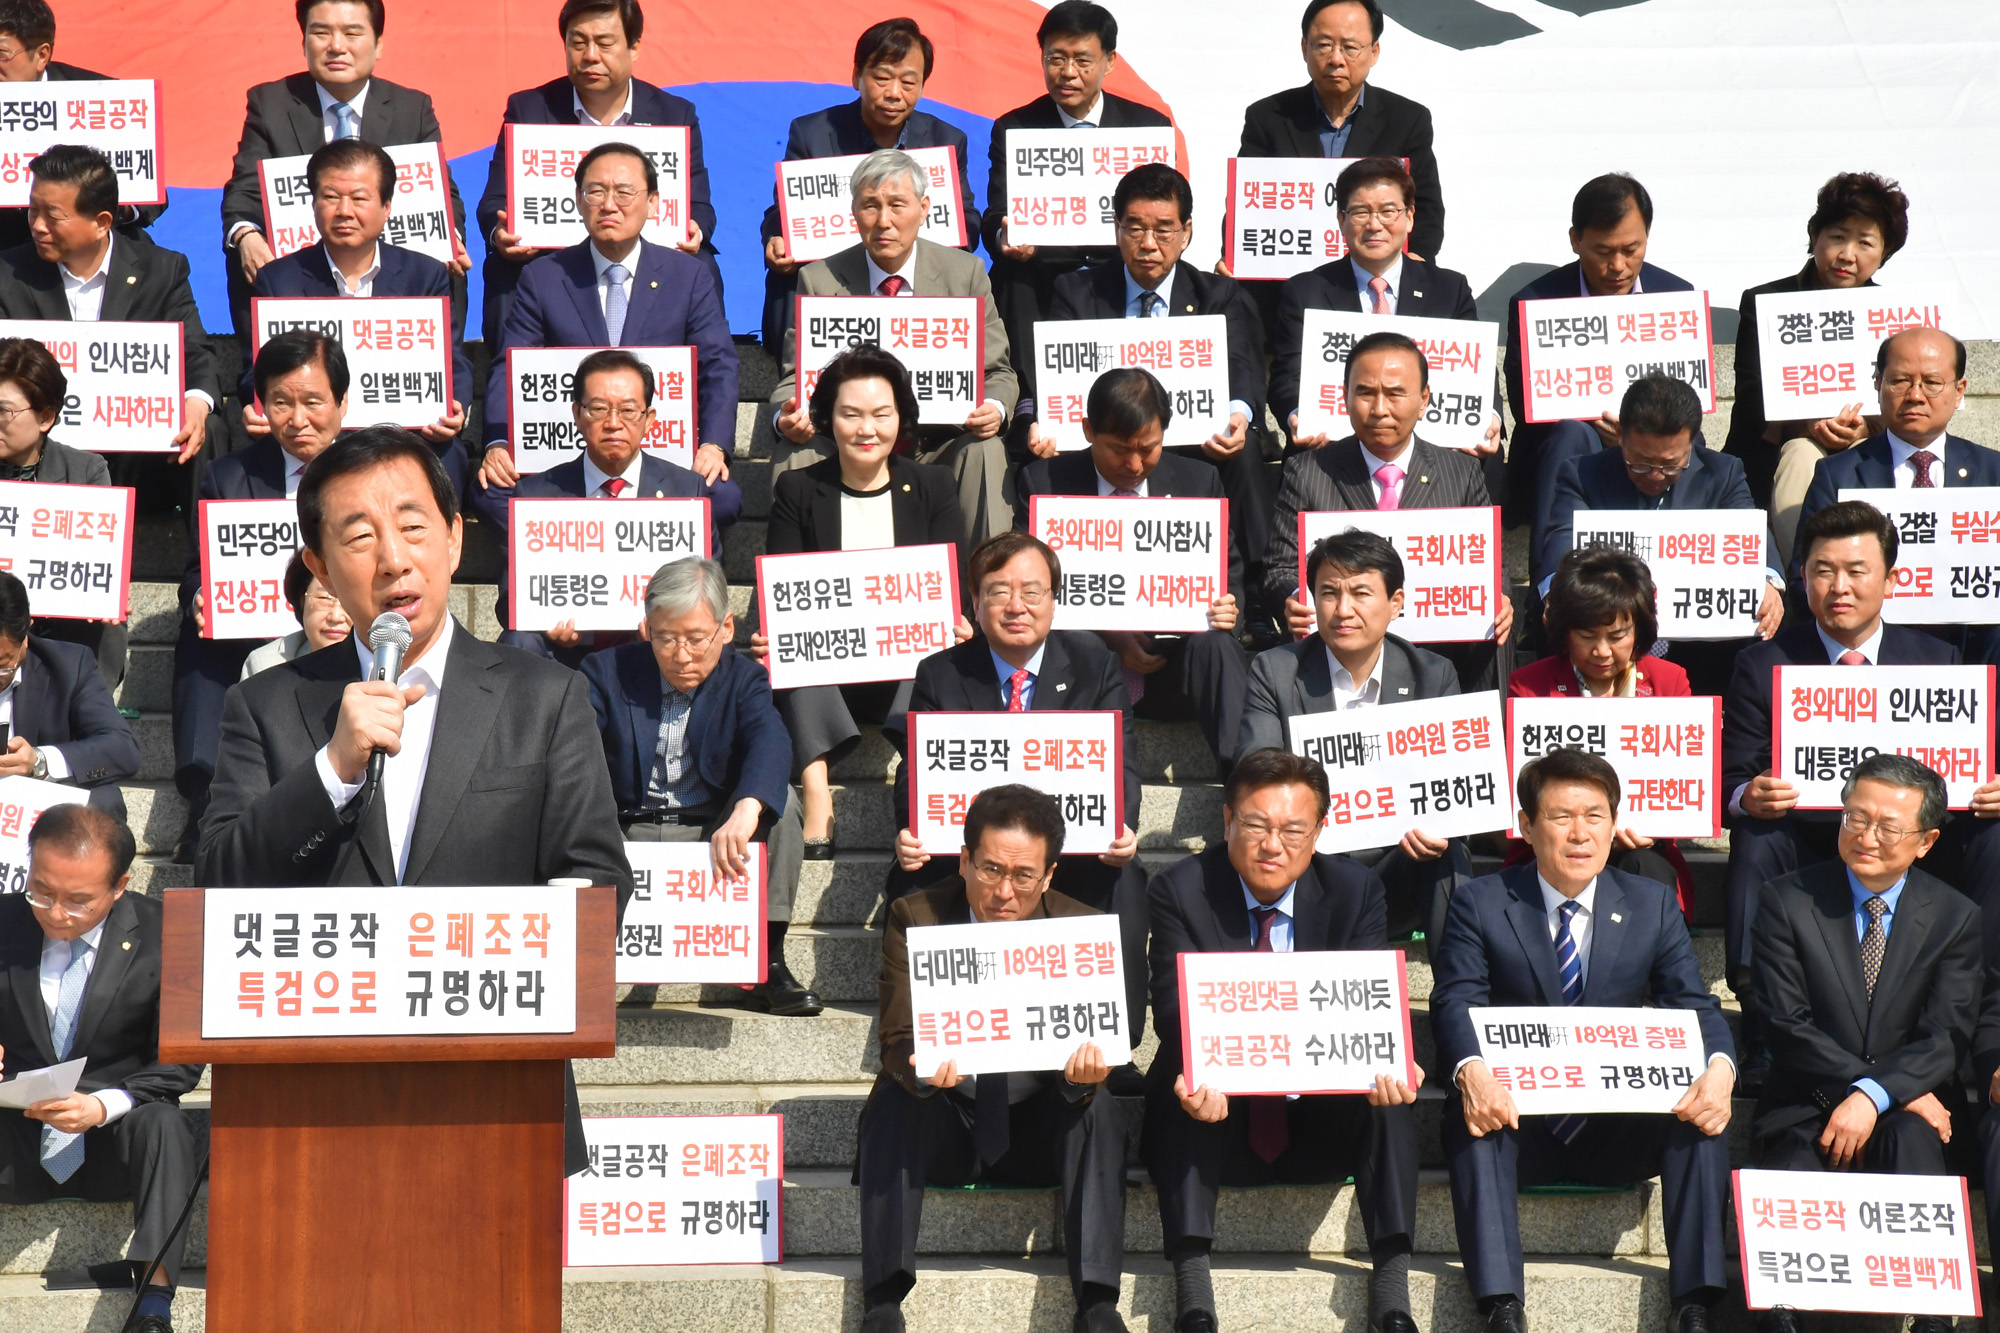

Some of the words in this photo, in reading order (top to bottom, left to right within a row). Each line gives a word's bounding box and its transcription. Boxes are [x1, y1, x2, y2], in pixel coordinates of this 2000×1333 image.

[0, 100, 57, 131] 주당의
[66, 99, 148, 130] 댓글공작
[104, 149, 155, 181] 백계
[522, 150, 587, 178] 댓글공
[1015, 147, 1083, 178] 민주당의
[275, 174, 313, 207] 민주
[395, 160, 435, 194] 공작
[1244, 180, 1315, 211] 댓글공작
[522, 196, 585, 227] 특검으
[1012, 196, 1087, 227] 진상규명
[276, 225, 316, 257] 진상
[378, 210, 448, 244] 벌백계
[1242, 227, 1313, 257] 특검으로
[353, 318, 436, 351] 댓글공작
[810, 316, 880, 350] 민주당의
[890, 316, 970, 350] 댓글공작
[1535, 315, 1608, 348] 민주당의
[1617, 310, 1700, 343] 댓글공작
[1777, 310, 1855, 345] 경찰·검찰
[88, 342, 171, 376] 인사참사
[1119, 340, 1173, 369] 18억원
[1179, 339, 1214, 369] 증발
[360, 371, 444, 404] 일벌백계
[520, 372, 577, 403] 헌정유
[907, 369, 975, 402] 벌백계
[1533, 364, 1614, 398] 진상규명
[1782, 362, 1857, 397] 특검으로
[93, 395, 175, 429] 사과하라
[1047, 394, 1084, 425] 특검
[1168, 388, 1214, 419] 하라
[1420, 393, 1483, 426] 상규명
[522, 421, 587, 450] 문재인정
[640, 421, 686, 450] 한다
[31, 507, 118, 542] 은폐조작
[217, 521, 299, 558] 민주당의
[525, 520, 604, 553] 청와대의
[615, 520, 695, 553] 인사참사
[1045, 519, 1123, 552] 청와대의
[1133, 519, 1213, 553] 인사참사
[1950, 511, 2000, 544] 부실수
[1406, 533, 1487, 567] 국회사찰
[1658, 533, 1716, 566] 18억원
[1723, 532, 1762, 566] 증발
[27, 559, 114, 595] 규명하라
[529, 574, 609, 608] 대통령은
[772, 577, 853, 612] 헌정유린
[864, 571, 943, 605] 국회사찰
[1136, 574, 1215, 608] 사과하라
[1884, 566, 1934, 600] 으로
[214, 579, 297, 615] 진상규
[1414, 585, 1488, 618] 규탄한다
[1672, 586, 1759, 620] 규명하라
[777, 627, 868, 664] 문재인정권
[875, 621, 948, 657] 규탄한다
[1791, 687, 1878, 723] 청와대의
[1888, 688, 1978, 724] 인사참사
[1386, 722, 1448, 758] 18억원
[1451, 716, 1491, 753] 증발
[1619, 724, 1706, 758] 국회사찰
[926, 739, 1011, 772] 댓글공작
[1022, 738, 1107, 772] 은폐조작
[926, 793, 978, 826] 특검
[1321, 785, 1397, 829] 검으로
[1409, 771, 1497, 817] 규명하라
[1627, 777, 1706, 812] 규탄한다
[233, 911, 380, 960] 댓글공작
[407, 911, 551, 960] 은폐조작
[672, 923, 751, 958] 규탄한다
[1003, 943, 1067, 978] 18억원
[1074, 941, 1116, 977] 증발
[237, 969, 378, 1018] 특검으로
[405, 968, 545, 1017] 규명하라
[1196, 980, 1298, 1014] 국정원댓글
[1308, 979, 1392, 1012] 수사하듯
[917, 1008, 1011, 1047] 특검으로
[1026, 1001, 1120, 1041] 규명하라
[1574, 1024, 1639, 1050] 18억원
[1645, 1025, 1686, 1050] 증발
[1200, 1034, 1292, 1068] 댓글공작
[1304, 1032, 1396, 1067] 수사하라
[1491, 1065, 1587, 1091] 특검으로
[1600, 1065, 1694, 1091] 규명하라
[680, 1142, 770, 1179] 은폐조작
[577, 1200, 668, 1237] 특검으로
[680, 1200, 770, 1236] 규명하라
[1751, 1197, 1846, 1233] 댓글공작
[1858, 1200, 1956, 1236] 여론조작
[1757, 1251, 1852, 1287] 특검으로
[1864, 1254, 1962, 1292] 일벌백계
